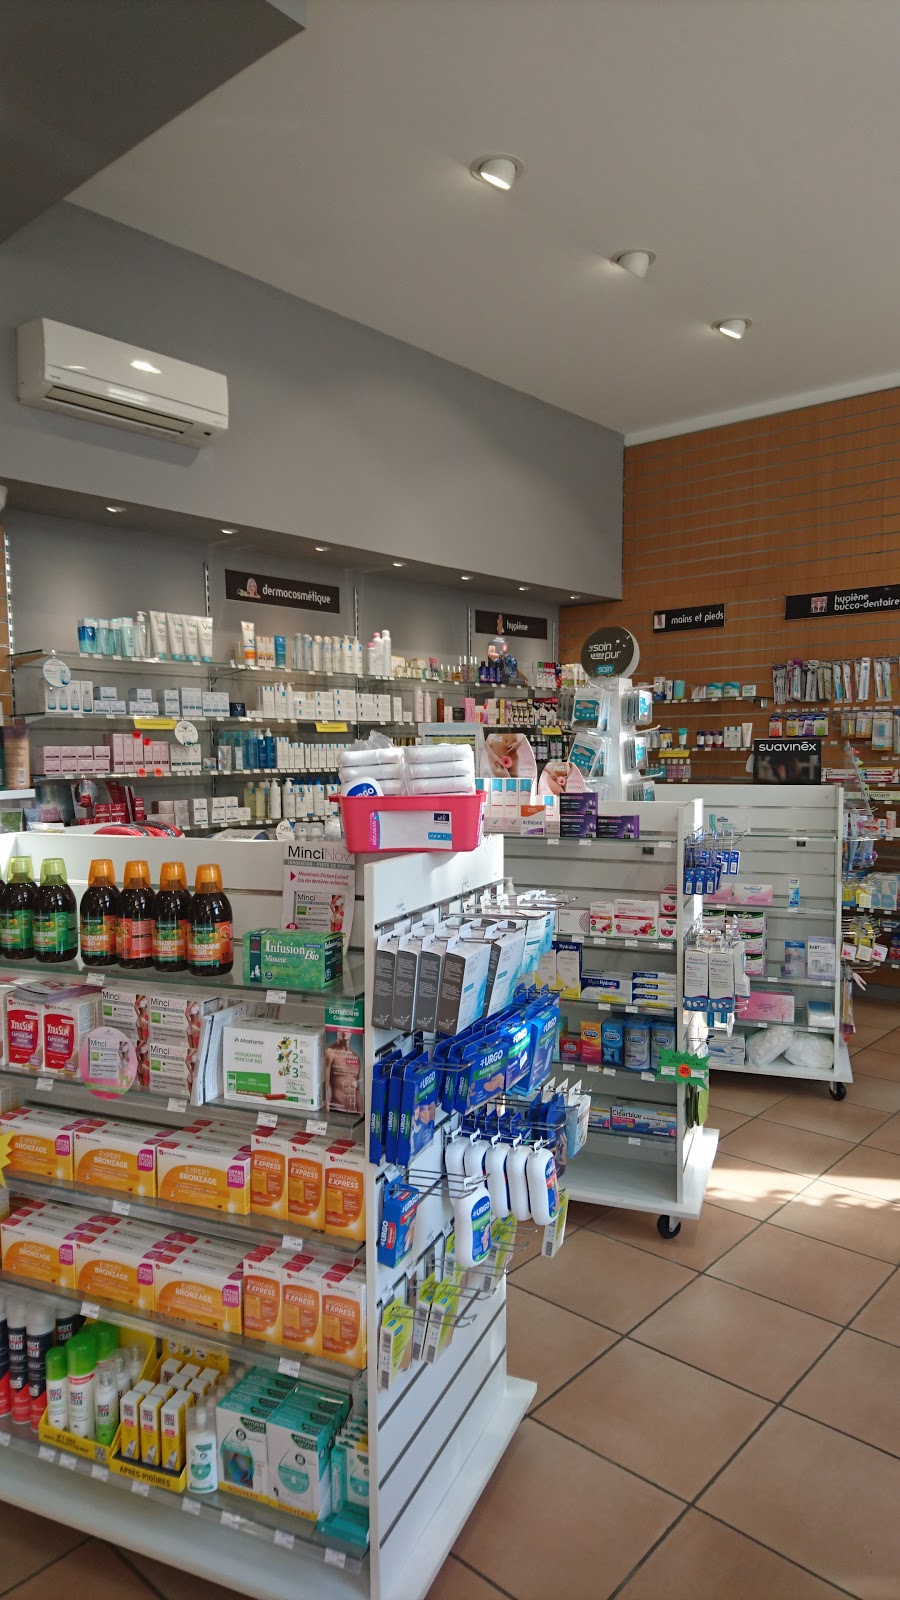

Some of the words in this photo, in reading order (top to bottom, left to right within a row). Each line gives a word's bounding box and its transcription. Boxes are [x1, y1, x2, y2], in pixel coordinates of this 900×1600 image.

[262, 584, 331, 605] dermocosmétique
[835, 593, 869, 604] hygiène
[834, 598, 900, 611] bucco-dentaire
[671, 614, 692, 624] mains
[694, 612, 702, 622] et
[704, 610, 724, 623] pieds
[506, 620, 528, 632] hygiène
[598, 665, 613, 673] soin
[265, 940, 305, 955] Infusion
[304, 950, 319, 961] Bio
[329, 1008, 359, 1017] Somatoline
[293, 1039, 298, 1050] 1
[292, 1053, 299, 1064] 2
[484, 1050, 503, 1067] URGO
[292, 1067, 299, 1078] 3
[612, 1109, 642, 1120] Clearblue
[20, 1136, 40, 1145] EXPERT
[15, 1142, 47, 1154] BRONZAGE
[99, 1150, 122, 1159] EXPERT
[254, 1153, 280, 1164] BRONZAGE
[93, 1156, 128, 1169] BRONZAGE
[253, 1159, 281, 1170] EXPRESS
[291, 1162, 317, 1172] BRONZAGE
[185, 1167, 210, 1176] EXPERT
[290, 1168, 318, 1179] EXPRESS
[329, 1172, 357, 1181] BRONZAGE
[180, 1173, 217, 1185] BRONZAGE
[328, 1178, 359, 1189] EXPRESS
[476, 1202, 490, 1216] URGO
[381, 1220, 389, 1243] URGO
[19, 1248, 51, 1261] BRONZAGE
[94, 1267, 128, 1281] BRONZAGE
[175, 1288, 213, 1304] BRONZAGE
[246, 1284, 275, 1296] EXPRESS
[285, 1294, 315, 1307] EXPRESS
[325, 1304, 355, 1318] EXPRESS
